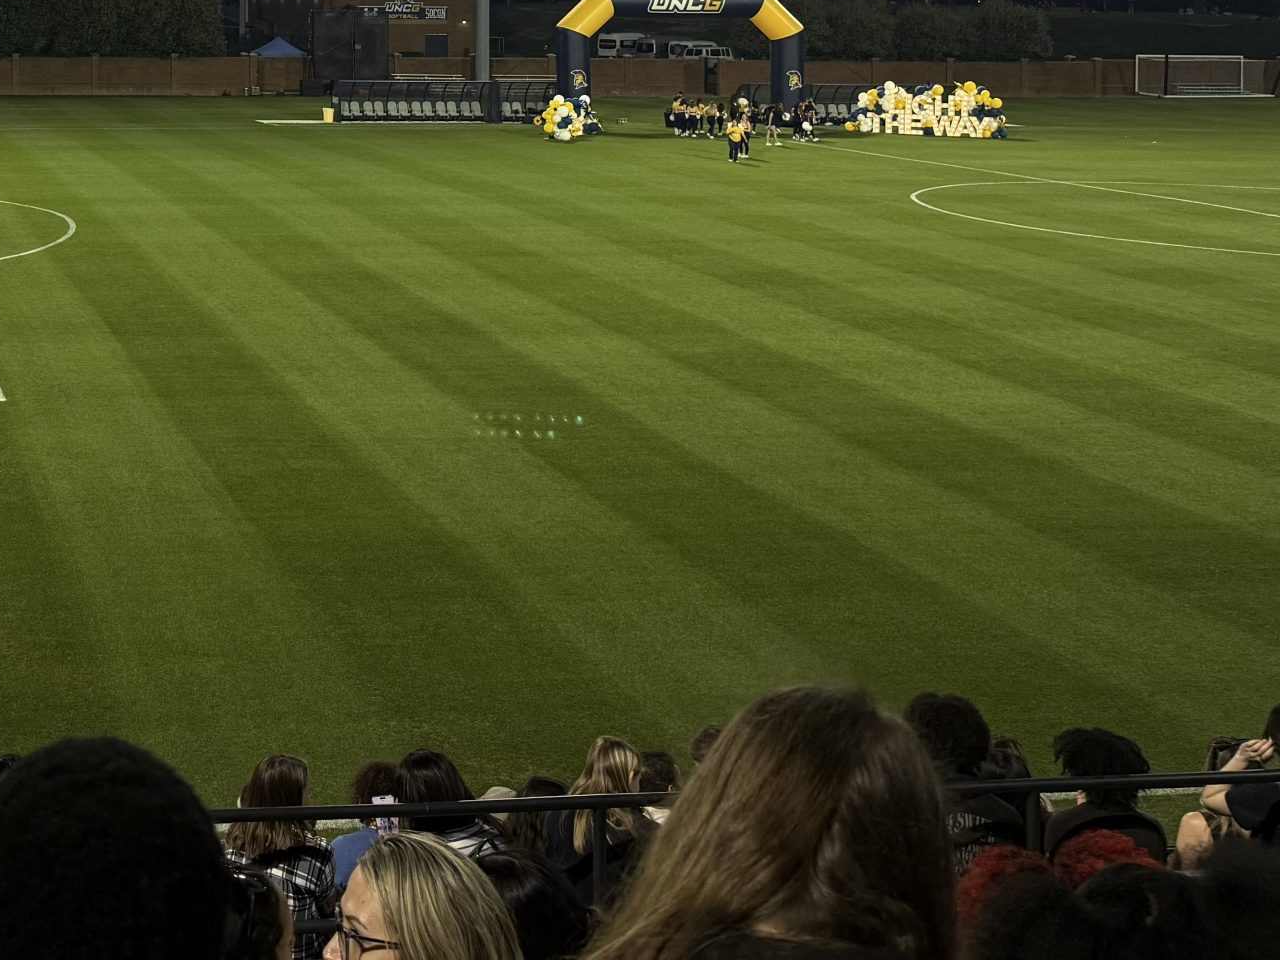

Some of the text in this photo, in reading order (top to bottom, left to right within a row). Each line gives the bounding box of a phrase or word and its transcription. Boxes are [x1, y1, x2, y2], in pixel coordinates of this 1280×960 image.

[385, 3, 421, 13] UNCG
[889, 93, 976, 117] LIGHT
[867, 111, 998, 138] THE WAY
